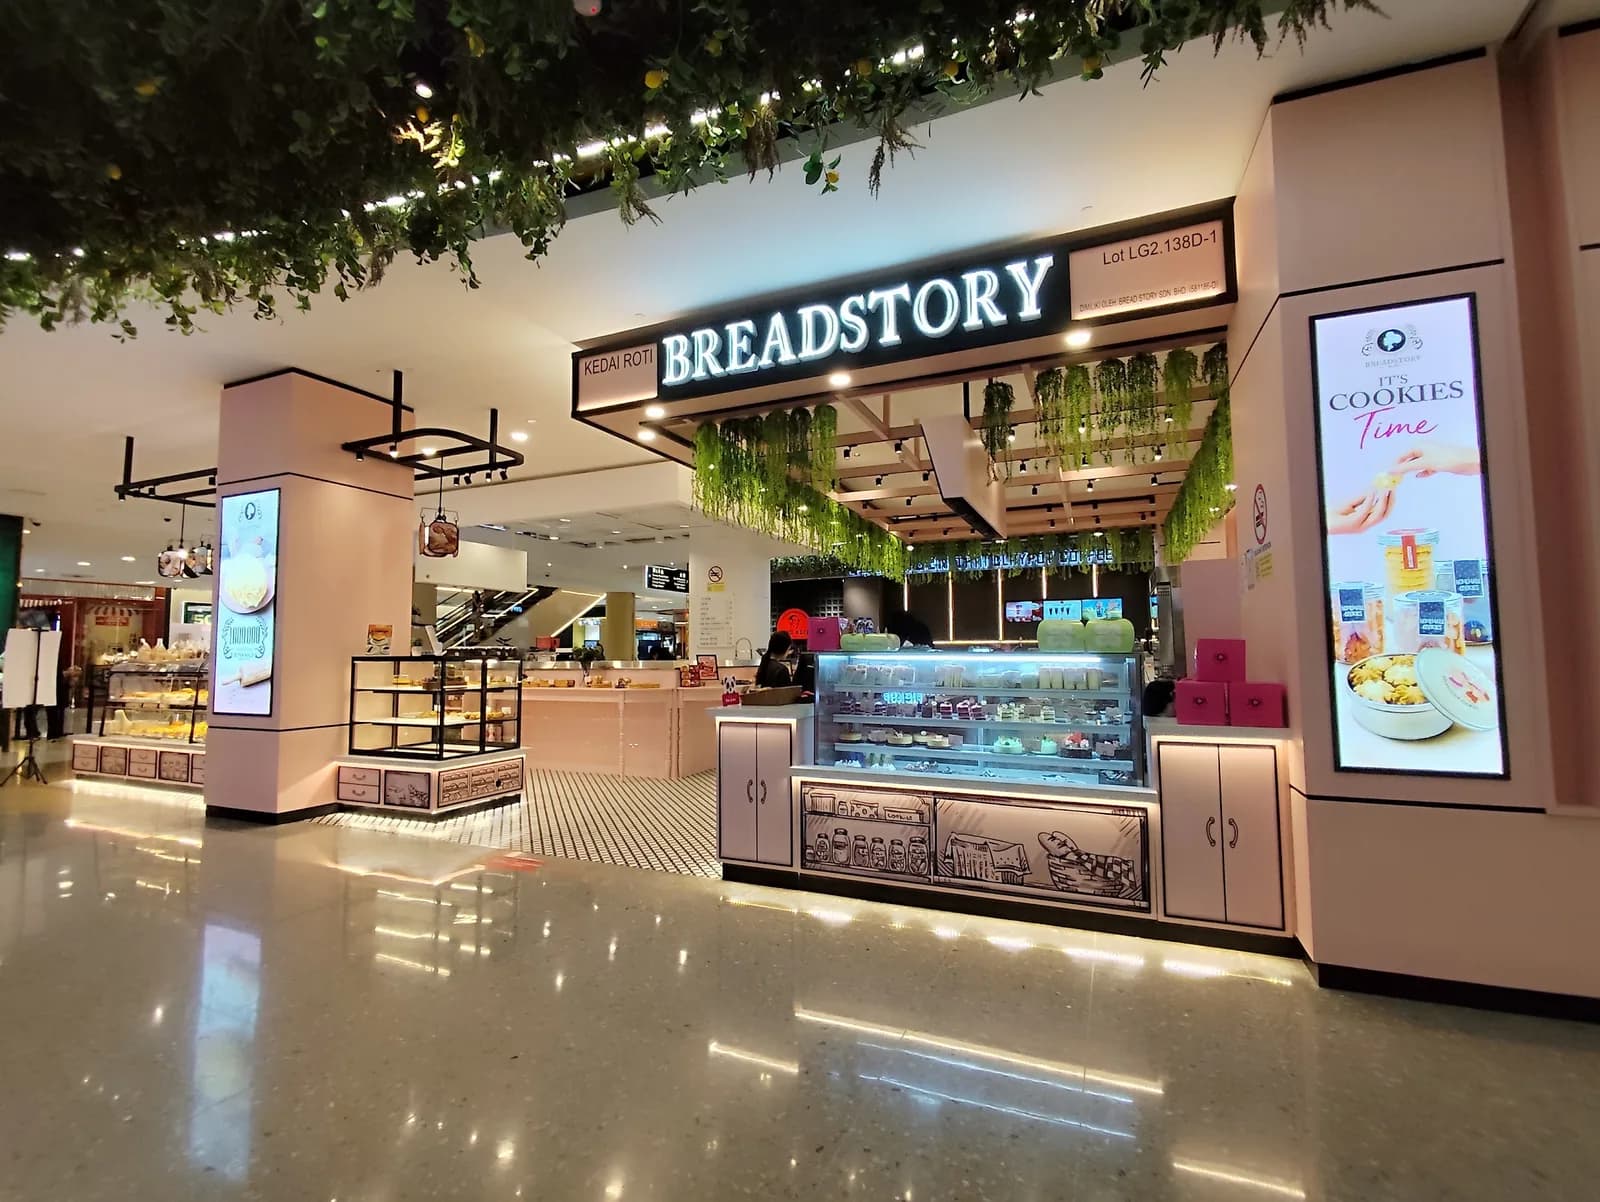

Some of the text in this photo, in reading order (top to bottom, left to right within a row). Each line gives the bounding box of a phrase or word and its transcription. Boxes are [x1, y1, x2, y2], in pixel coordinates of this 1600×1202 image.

[1103, 230, 1217, 265] Lot LG2.138D-1
[1118, 295, 1138, 306] BREAD
[1138, 291, 1158, 302] STORY
[661, 254, 1055, 387] BREADSTORY
[584, 348, 653, 376] KEDAI ROTI
[1329, 380, 1464, 411] COOKIES
[1378, 374, 1409, 387] IT'S
[1353, 406, 1439, 450] Time
